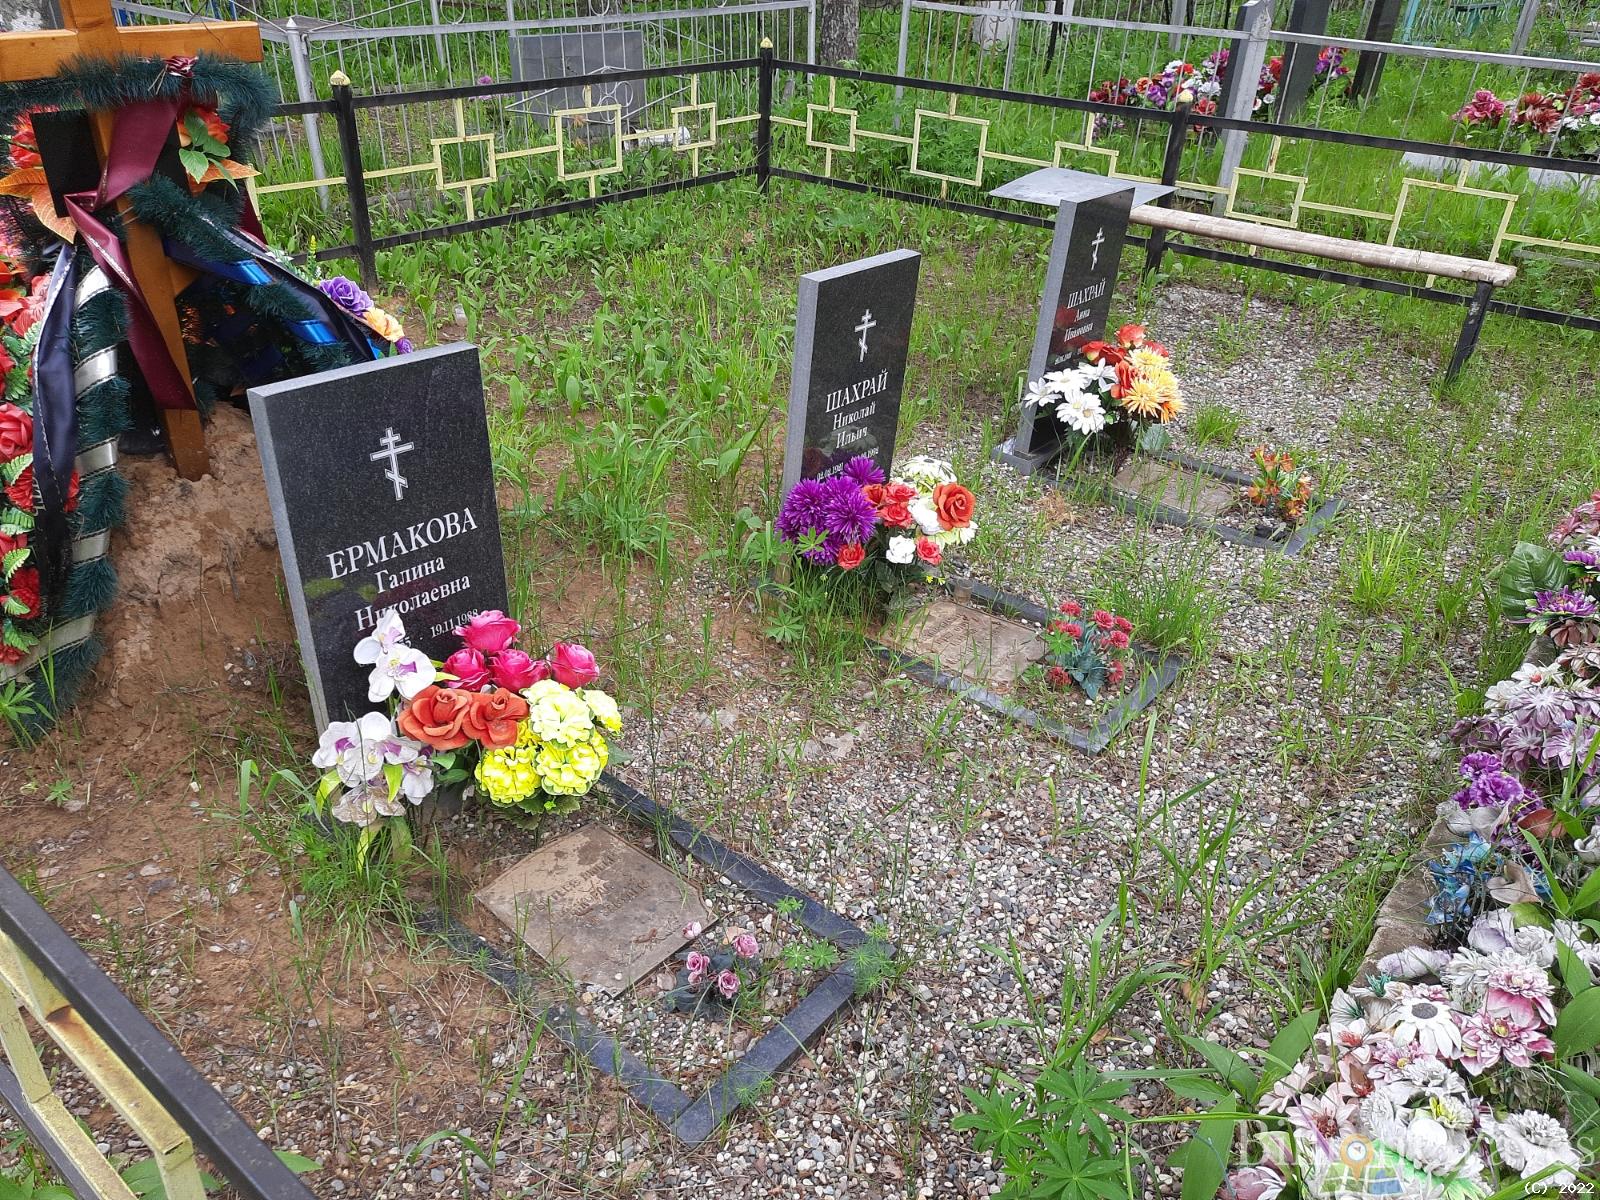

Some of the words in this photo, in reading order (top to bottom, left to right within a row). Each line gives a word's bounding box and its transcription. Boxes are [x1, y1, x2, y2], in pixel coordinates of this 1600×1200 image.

[1066, 277, 1106, 310] ШАХРАЙ
[825, 368, 889, 413] ШАХРАЙ
[832, 401, 876, 431] Николай
[835, 426, 869, 449] Ильич
[325, 507, 478, 580] ЕРМАКОВА
[374, 556, 446, 594] Галина
